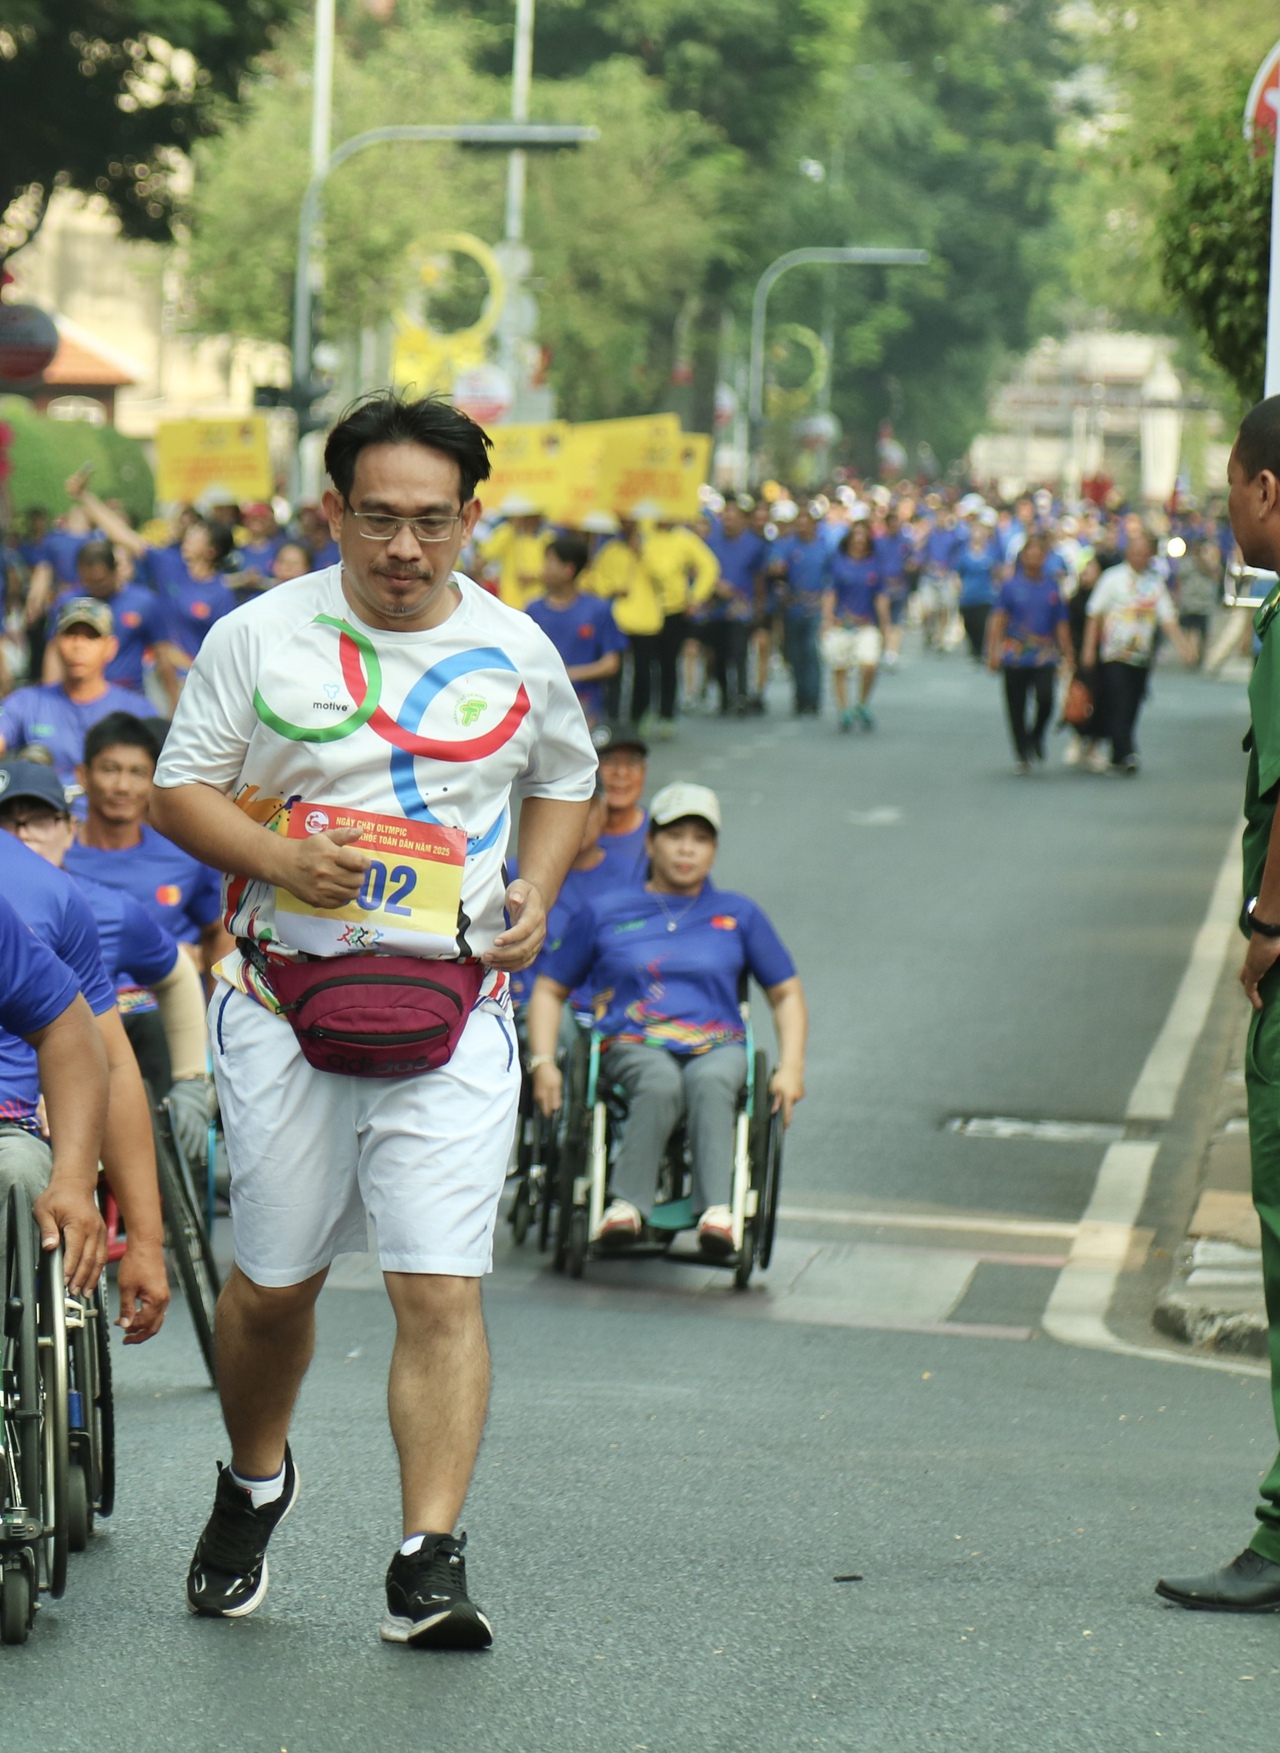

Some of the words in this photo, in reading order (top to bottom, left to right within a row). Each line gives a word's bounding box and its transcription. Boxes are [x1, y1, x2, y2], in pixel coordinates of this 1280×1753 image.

[313, 702, 348, 712] motive
[335, 816, 355, 828] NGÀY
[356, 820, 375, 833] CHẠY
[376, 824, 408, 837] OLYMPIC
[379, 835, 398, 847] TOÀN
[432, 846, 451, 856] 2025
[344, 860, 417, 917] 02
[326, 1053, 430, 1074] adidas
